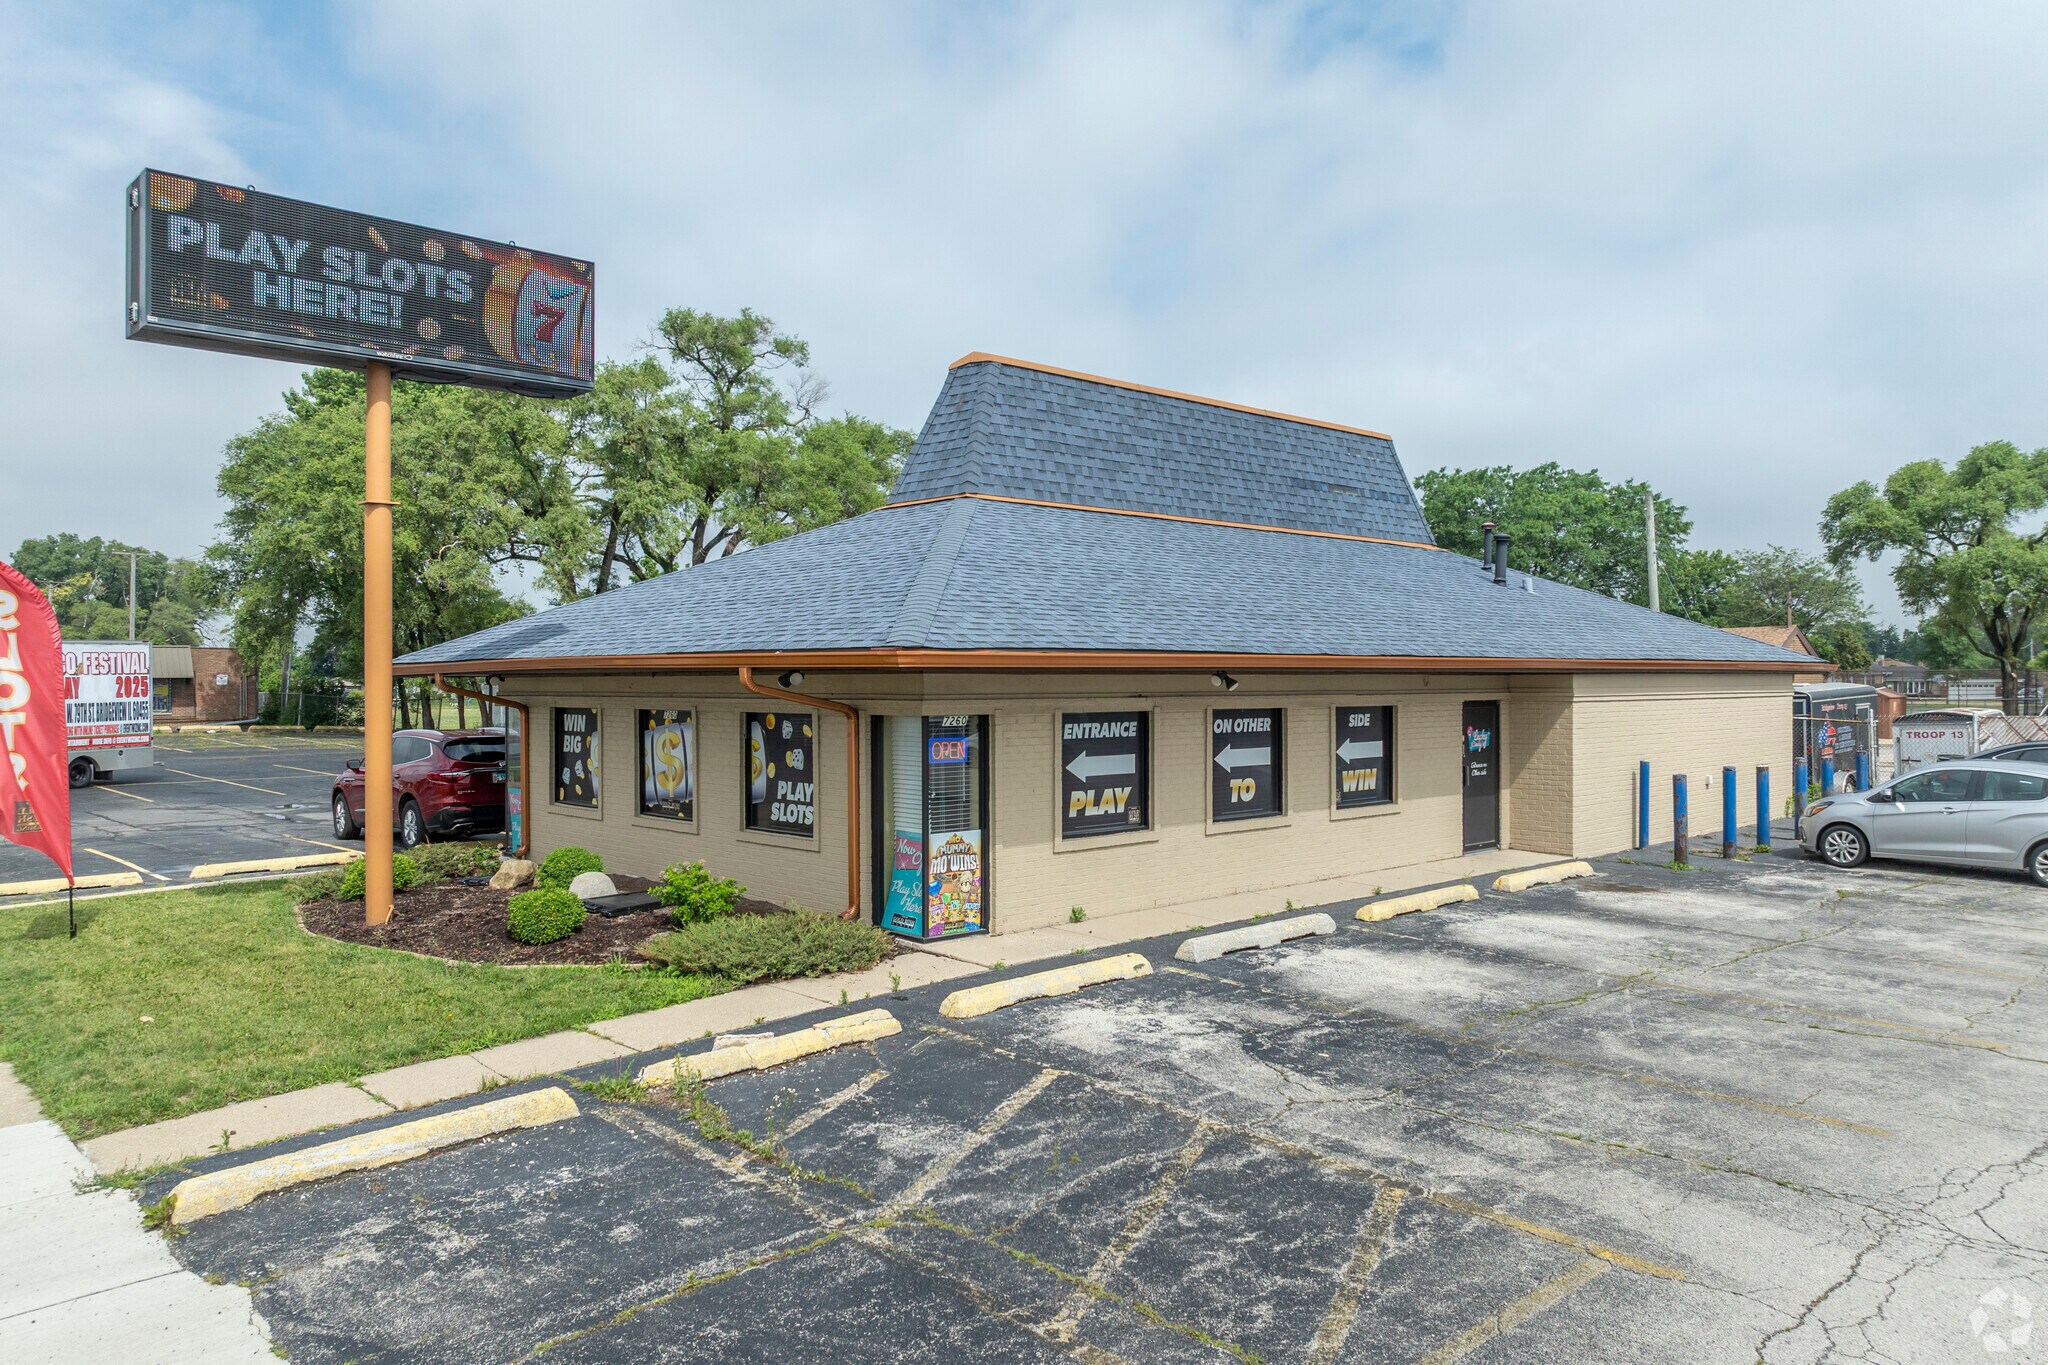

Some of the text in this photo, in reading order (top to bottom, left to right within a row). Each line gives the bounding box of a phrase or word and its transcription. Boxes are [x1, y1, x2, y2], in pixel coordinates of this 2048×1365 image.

[167, 215, 474, 303] PLAY SLOTS
[253, 271, 402, 329] HERE!
[532, 301, 564, 342] 7
[82, 652, 149, 675] FESTIVAL
[116, 676, 149, 698] 2025
[74, 703, 88, 723] 79TH
[96, 701, 127, 722] BRIDGEVIEW
[564, 714, 586, 732] WIN
[943, 716, 967, 726] 7260
[1348, 713, 1370, 727] SIDE
[1063, 721, 1137, 740] ENTRANCE
[1213, 717, 1271, 733] ON OTHER
[1906, 731, 1964, 739] TROOP 13
[563, 735, 582, 753] BIG
[932, 741, 966, 760] OPEN
[777, 780, 813, 802] PLAY
[1229, 778, 1256, 803] TO
[1342, 768, 1377, 793] WIN
[1069, 786, 1132, 818] PLAY
[770, 802, 814, 825] SLOTS
[896, 839, 916, 855] Now
[940, 844, 969, 854] MUMMY
[891, 880, 911, 905] Play
